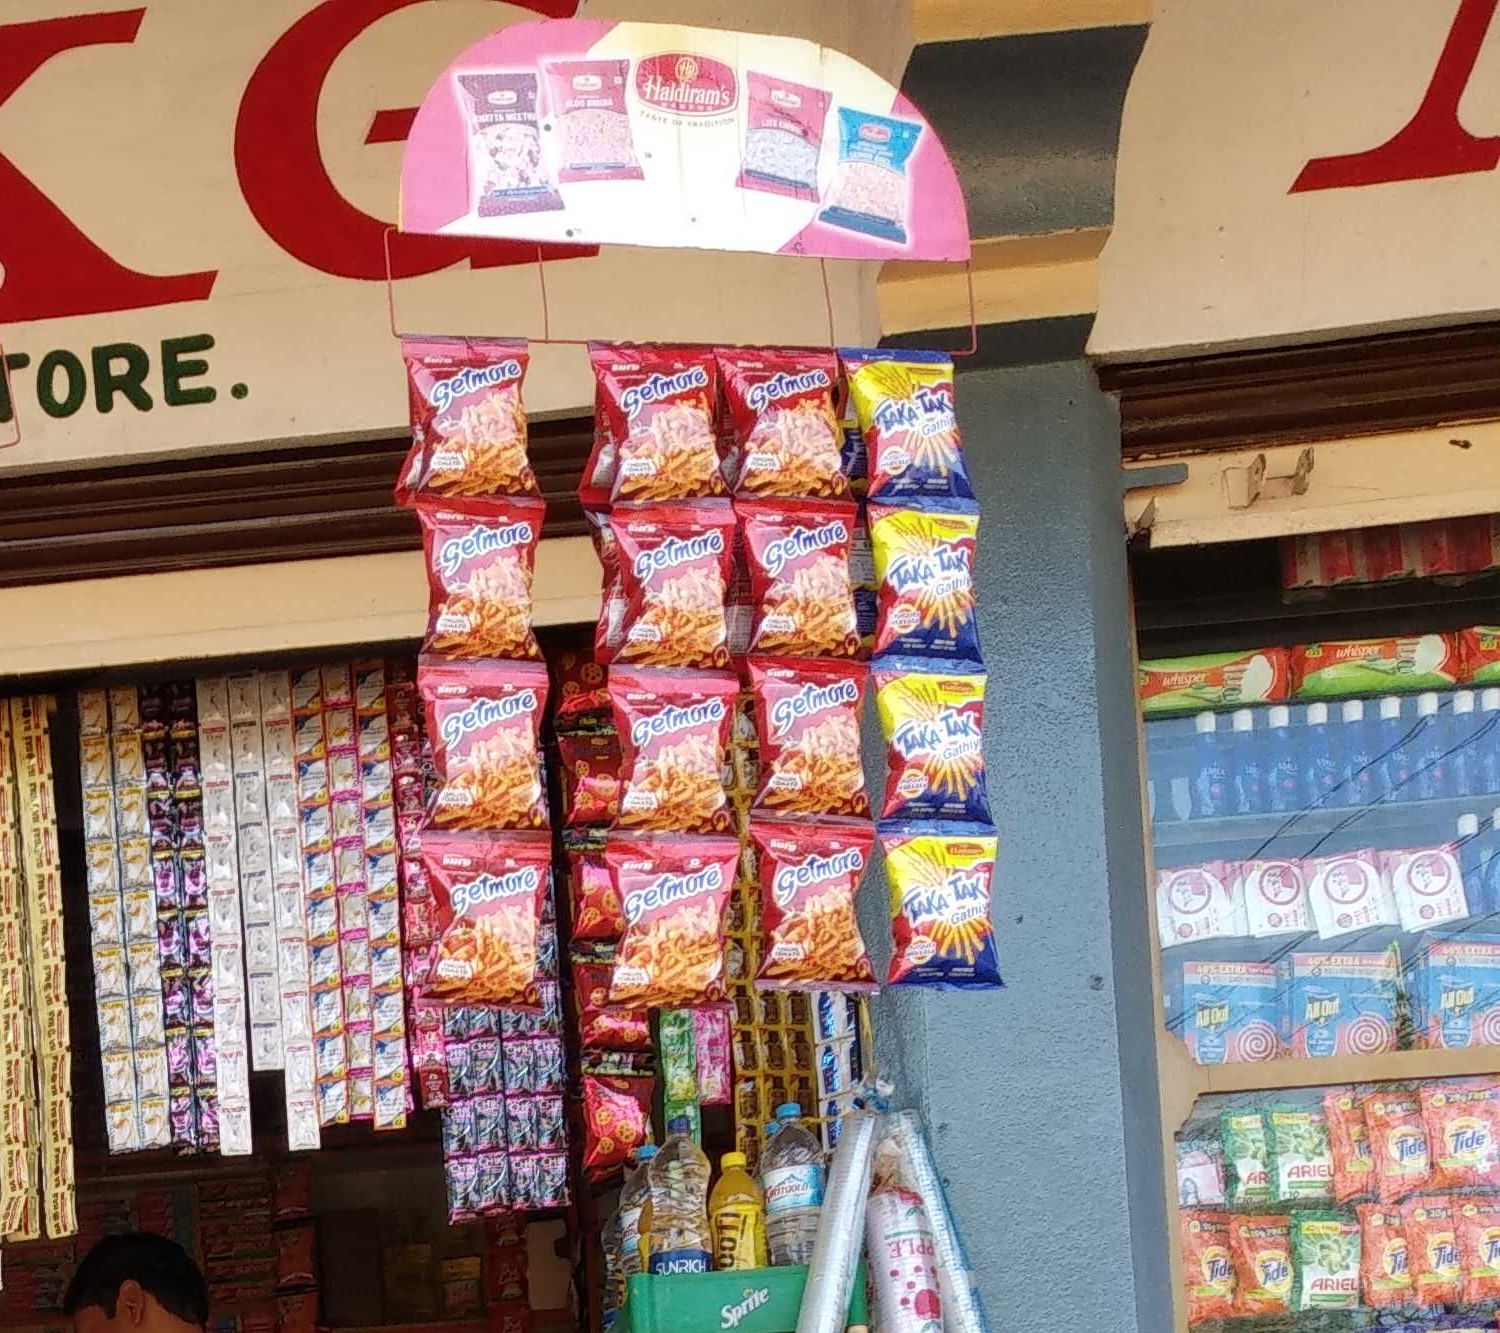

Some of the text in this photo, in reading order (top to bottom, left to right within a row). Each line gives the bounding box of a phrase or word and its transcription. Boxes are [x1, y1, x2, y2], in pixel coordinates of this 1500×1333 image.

[643, 76, 730, 106] Haldiram's
[235, 0, 600, 281] G
[1337, 644, 1382, 659] whisper
[1163, 671, 1208, 687] whisper
[1396, 1140, 1426, 1159] Tide
[1449, 1133, 1484, 1153] Tide
[1207, 1258, 1234, 1279] Tide
[1261, 1260, 1288, 1283] Tide
[1310, 1277, 1358, 1291] ARIEL
[720, 1286, 770, 1330] Sprite
